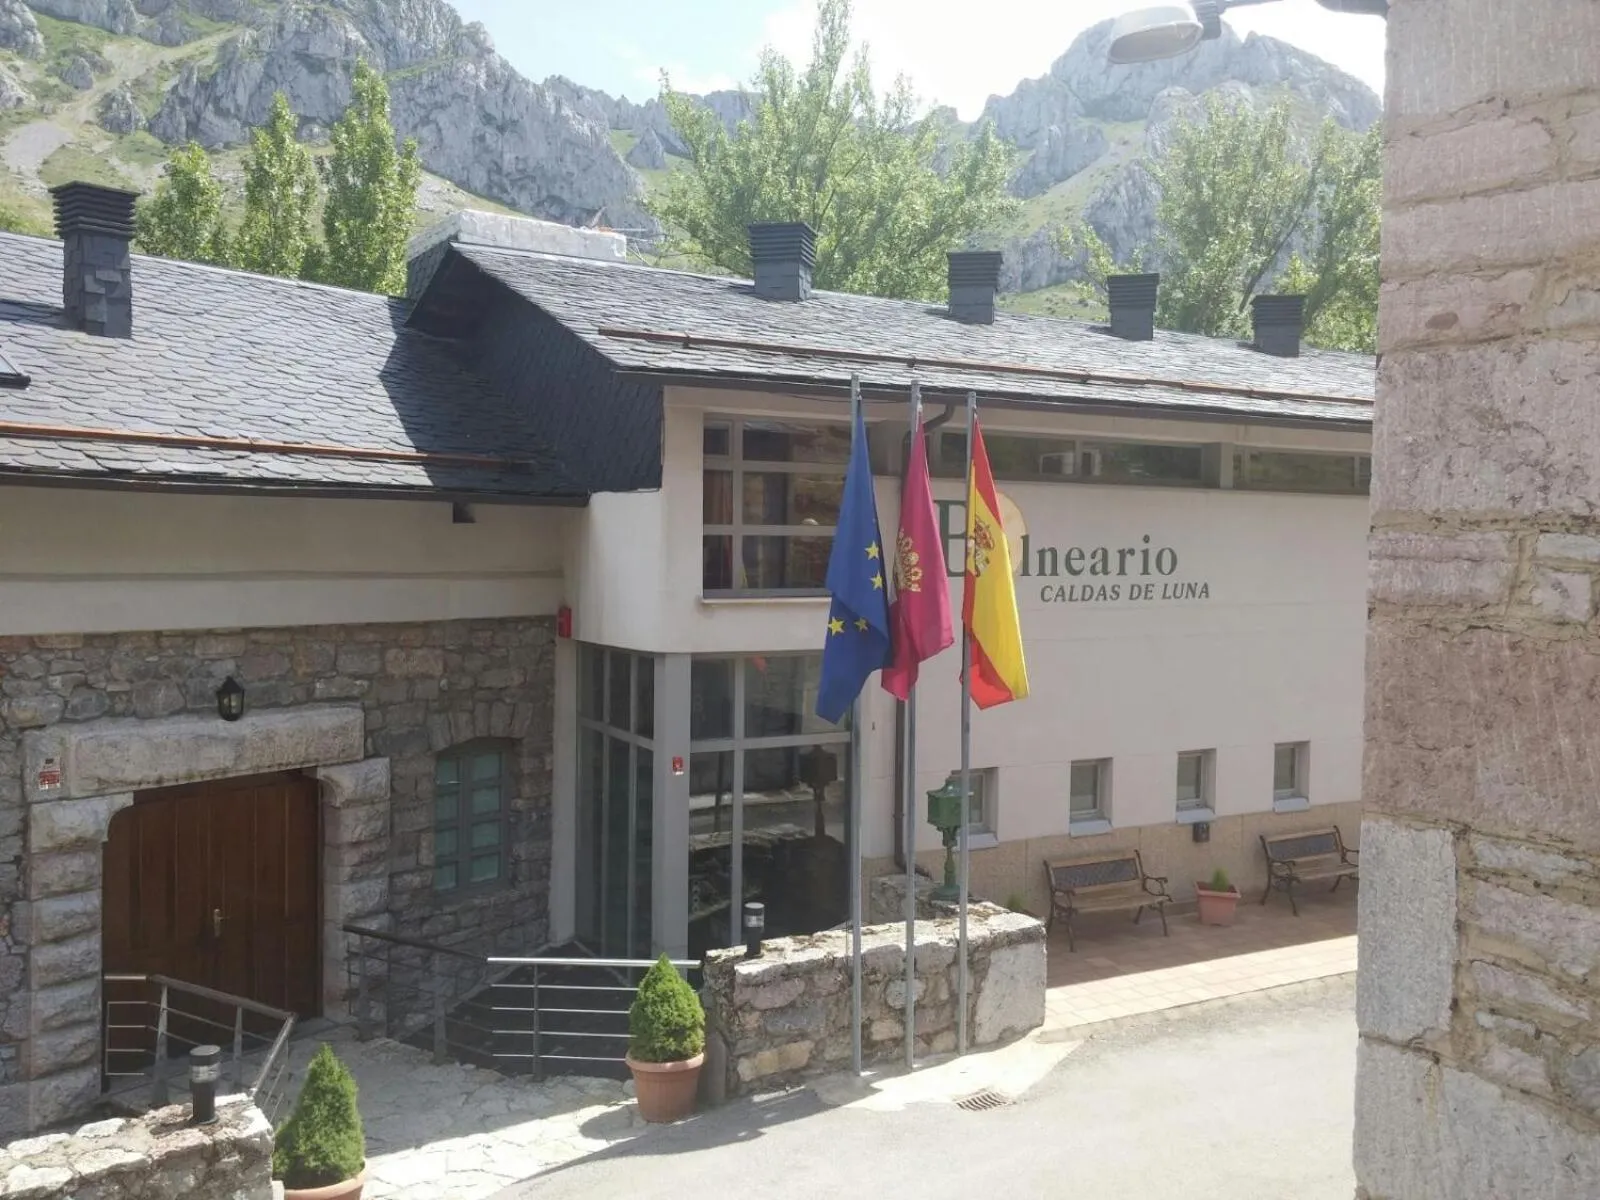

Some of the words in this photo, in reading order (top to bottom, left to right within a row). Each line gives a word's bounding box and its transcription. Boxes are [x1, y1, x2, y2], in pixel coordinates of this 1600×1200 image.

[933, 499, 1178, 577] Blneario
[1040, 584, 1121, 602] CALDAS
[1128, 583, 1155, 600] DE
[1161, 582, 1210, 600] LUNA
